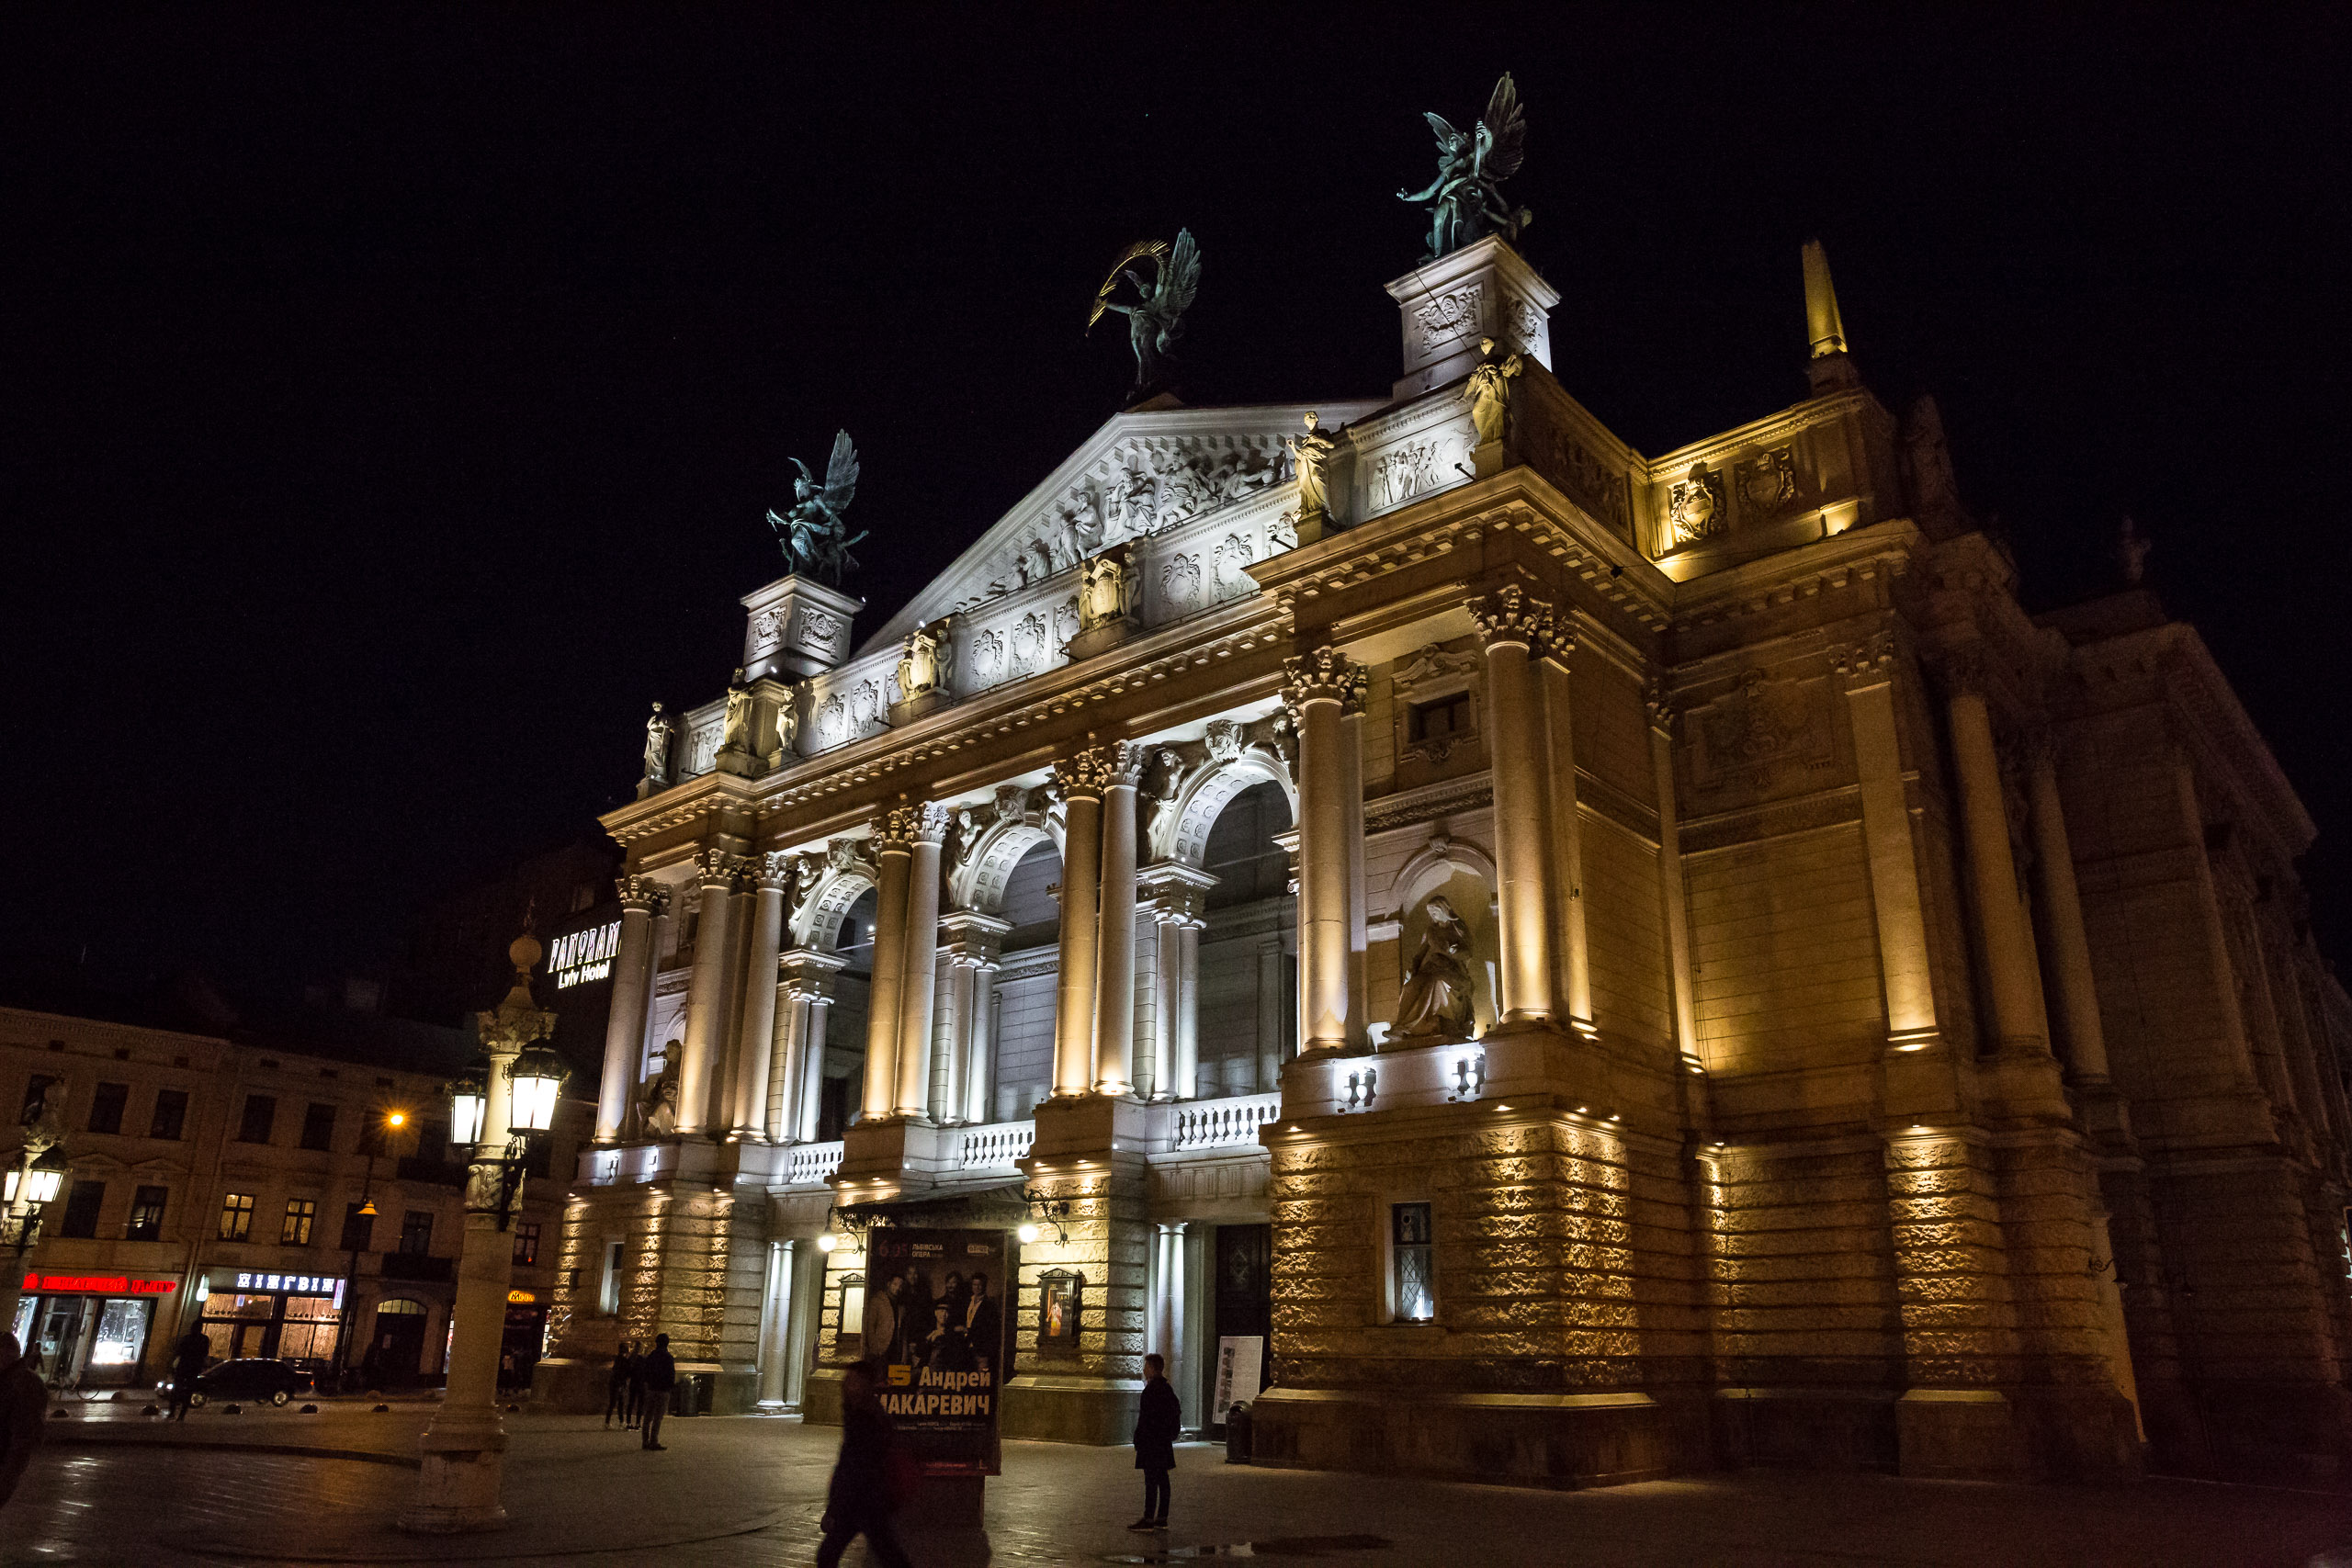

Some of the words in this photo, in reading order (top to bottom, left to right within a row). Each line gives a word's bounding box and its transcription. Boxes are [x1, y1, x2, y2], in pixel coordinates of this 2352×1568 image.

[548, 920, 622, 974] PANORAM
[558, 969, 580, 989] Lviv
[581, 960, 610, 984] Hotel
[237, 1273, 335, 1292] ПІНГВІН
[919, 1366, 991, 1392] Андрей
